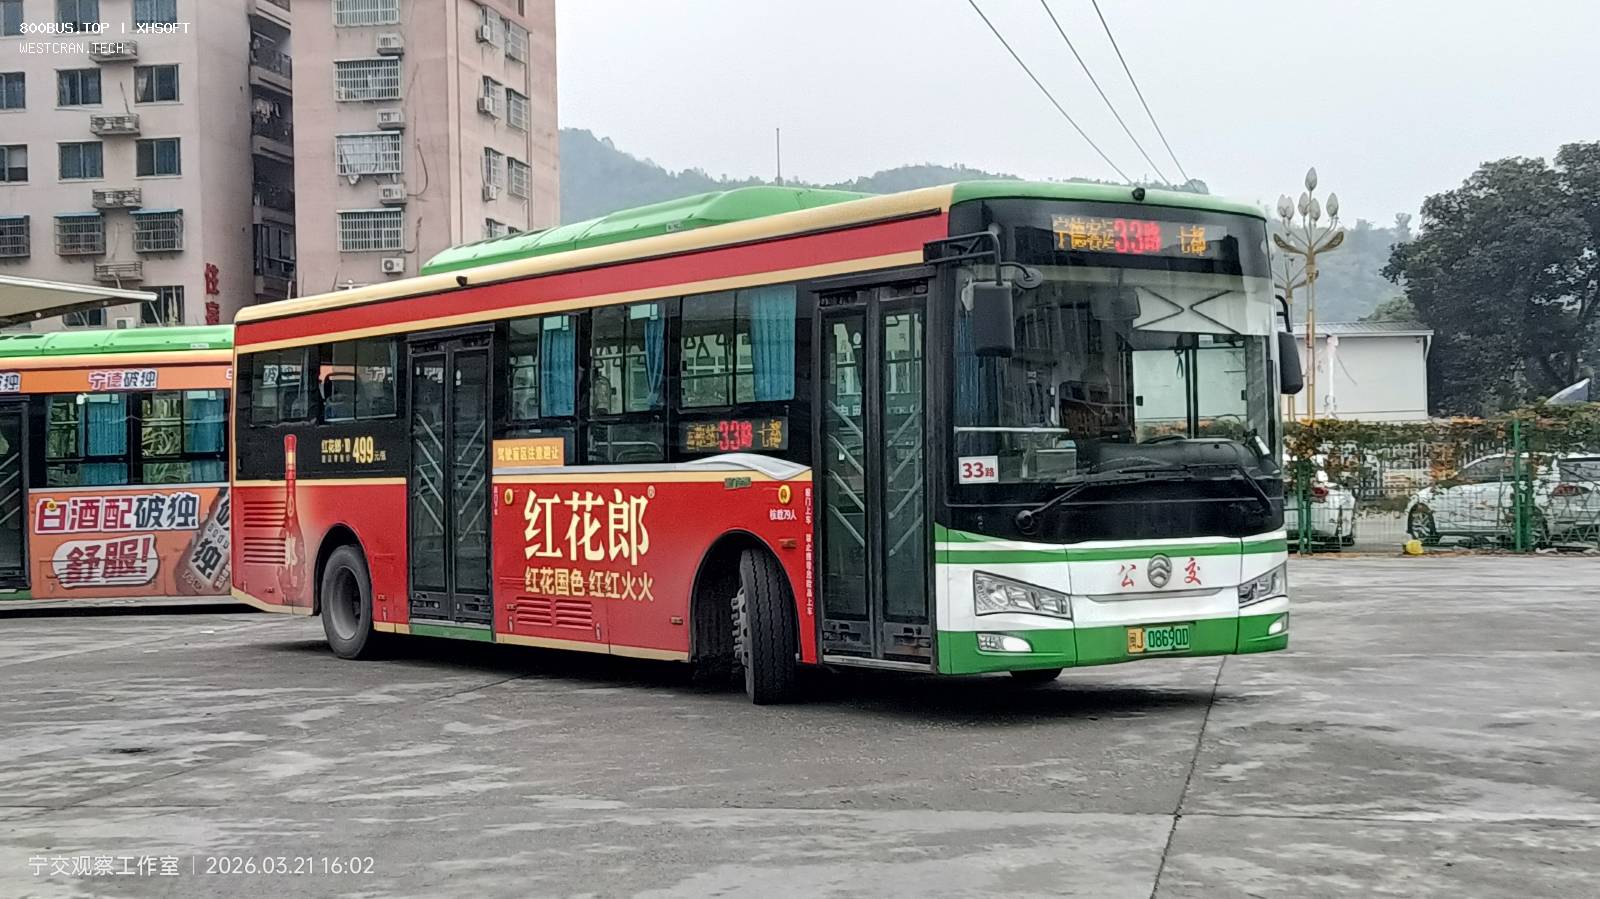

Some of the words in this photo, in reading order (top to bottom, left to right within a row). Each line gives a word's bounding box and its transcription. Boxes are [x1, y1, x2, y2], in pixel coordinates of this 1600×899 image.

[90, 370, 156, 389] 宁德破独
[962, 462, 995, 478] 33路
[37, 495, 198, 532] 白酒配破独
[524, 488, 650, 565] 红花郎
[525, 566, 586, 594] 红花国色
[589, 569, 654, 602] 红红火火
[1119, 563, 1137, 588] 公
[1184, 557, 1203, 586] 交
